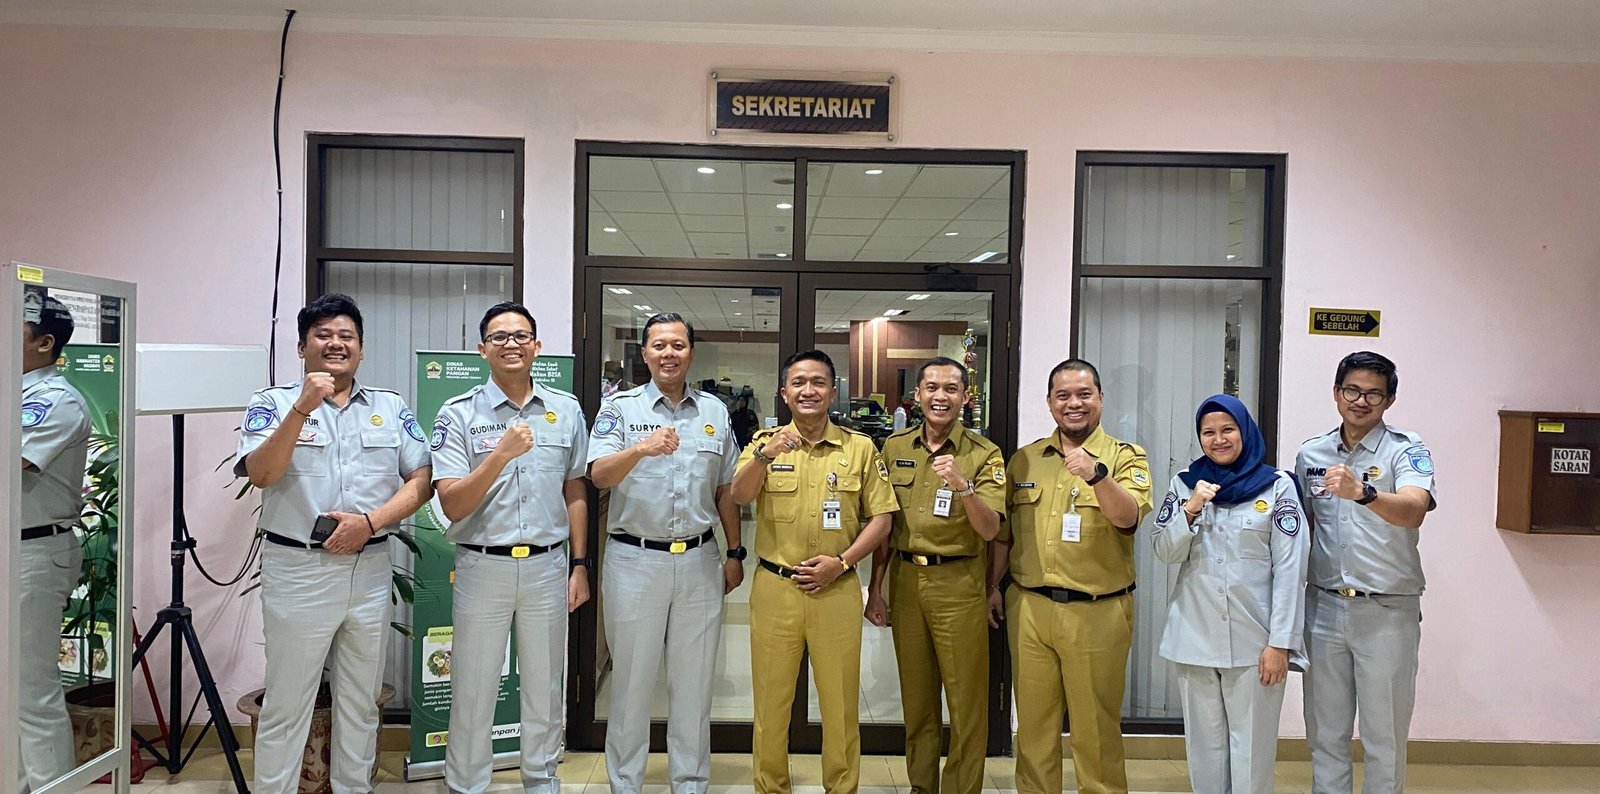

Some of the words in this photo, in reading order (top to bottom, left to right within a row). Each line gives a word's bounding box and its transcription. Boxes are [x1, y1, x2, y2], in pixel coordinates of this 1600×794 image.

[731, 95, 876, 119] SEKRETARIAT
[1316, 313, 1328, 321] KE
[1330, 314, 1366, 323] GEDUNG
[1322, 322, 1359, 331] SEBELAH
[304, 417, 319, 427] TUR
[470, 422, 507, 436] GUDIMAN
[1553, 449, 1589, 461] KOTAK
[1306, 467, 1327, 477] PAND
[1553, 461, 1589, 473] SARAN
